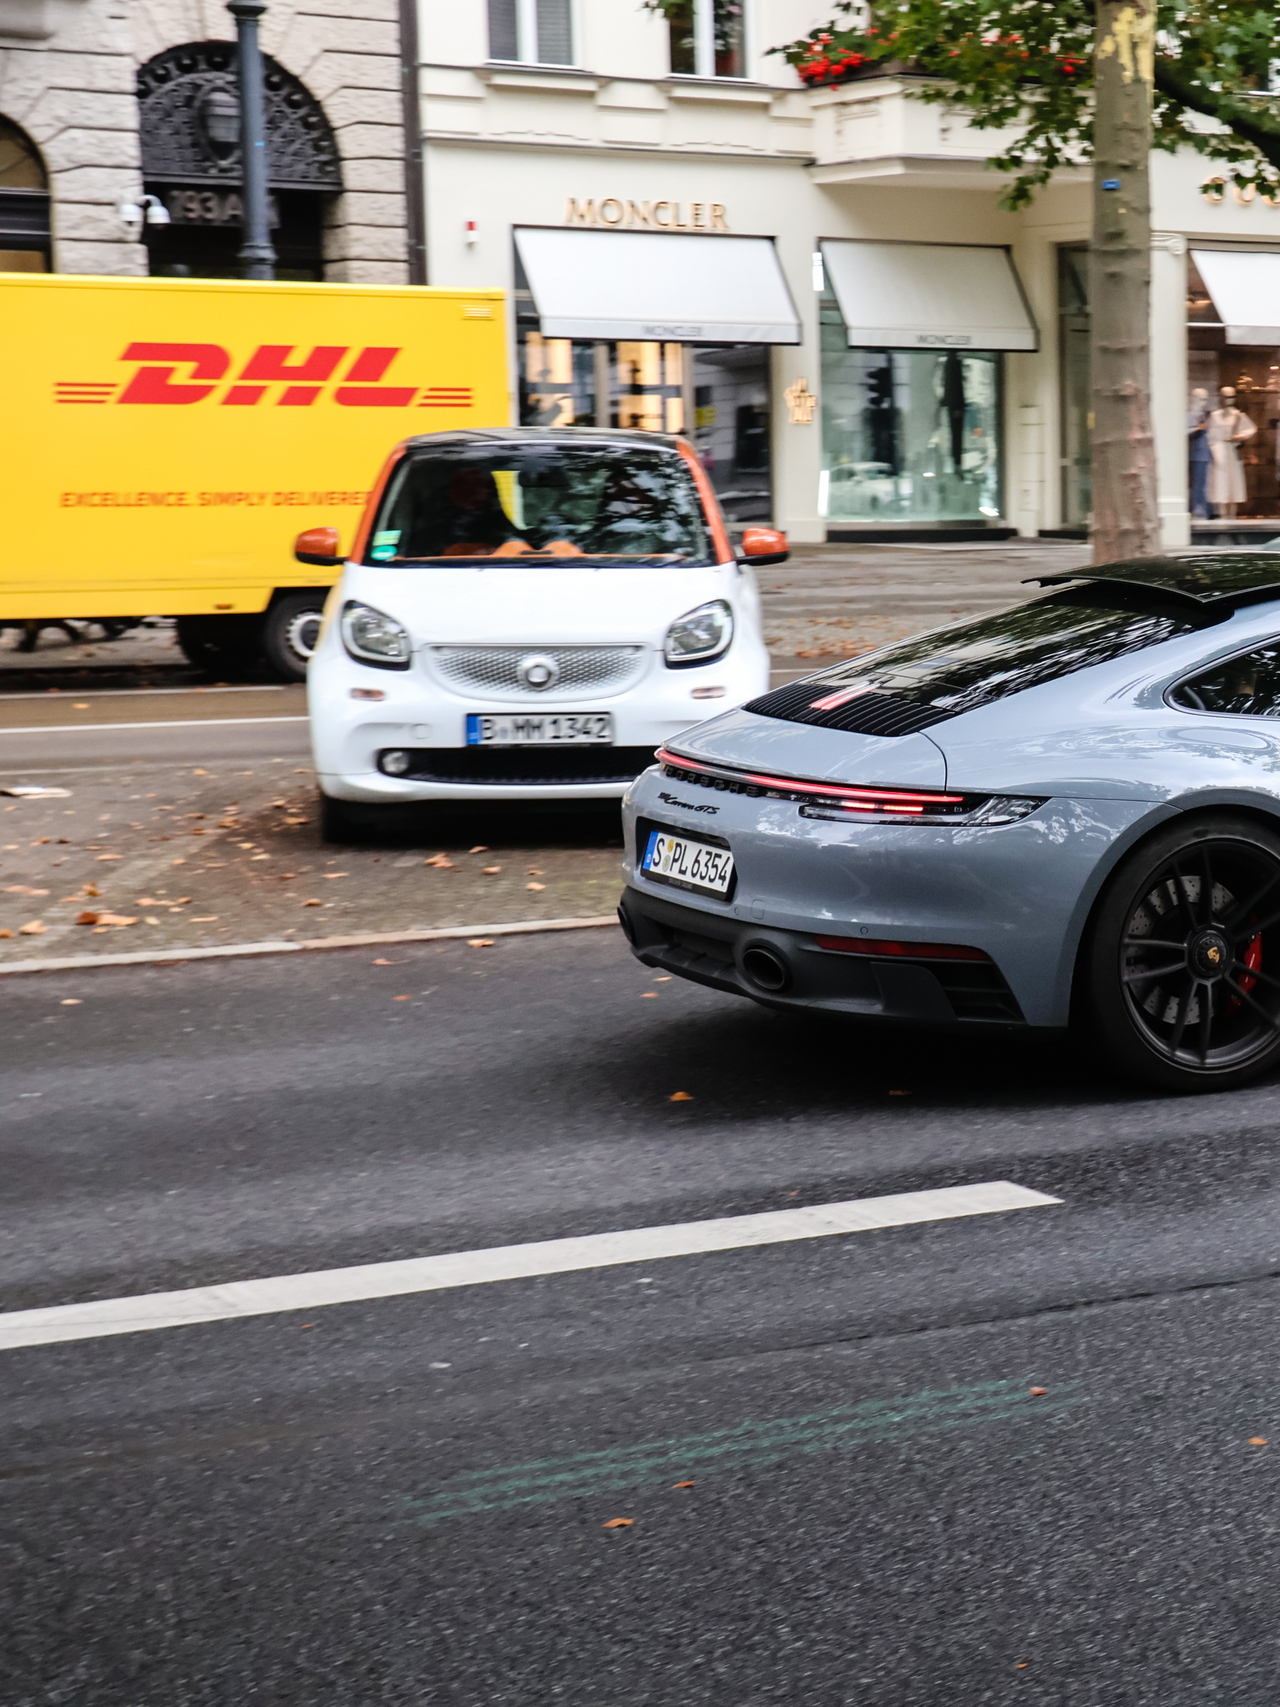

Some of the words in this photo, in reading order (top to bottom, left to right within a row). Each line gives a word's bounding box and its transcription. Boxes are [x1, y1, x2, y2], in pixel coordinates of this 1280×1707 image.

[564, 197, 731, 230] MONCLER
[115, 342, 420, 407] DHL
[197, 491, 270, 507] SIMPLY
[481, 717, 496, 740] B
[550, 717, 609, 740] 1342
[664, 764, 760, 797] PORSCHE
[664, 797, 695, 810] Carrera
[694, 805, 720, 815] GTS
[652, 837, 665, 867] S
[669, 842, 688, 875] PL
[691, 848, 731, 887] 6354
